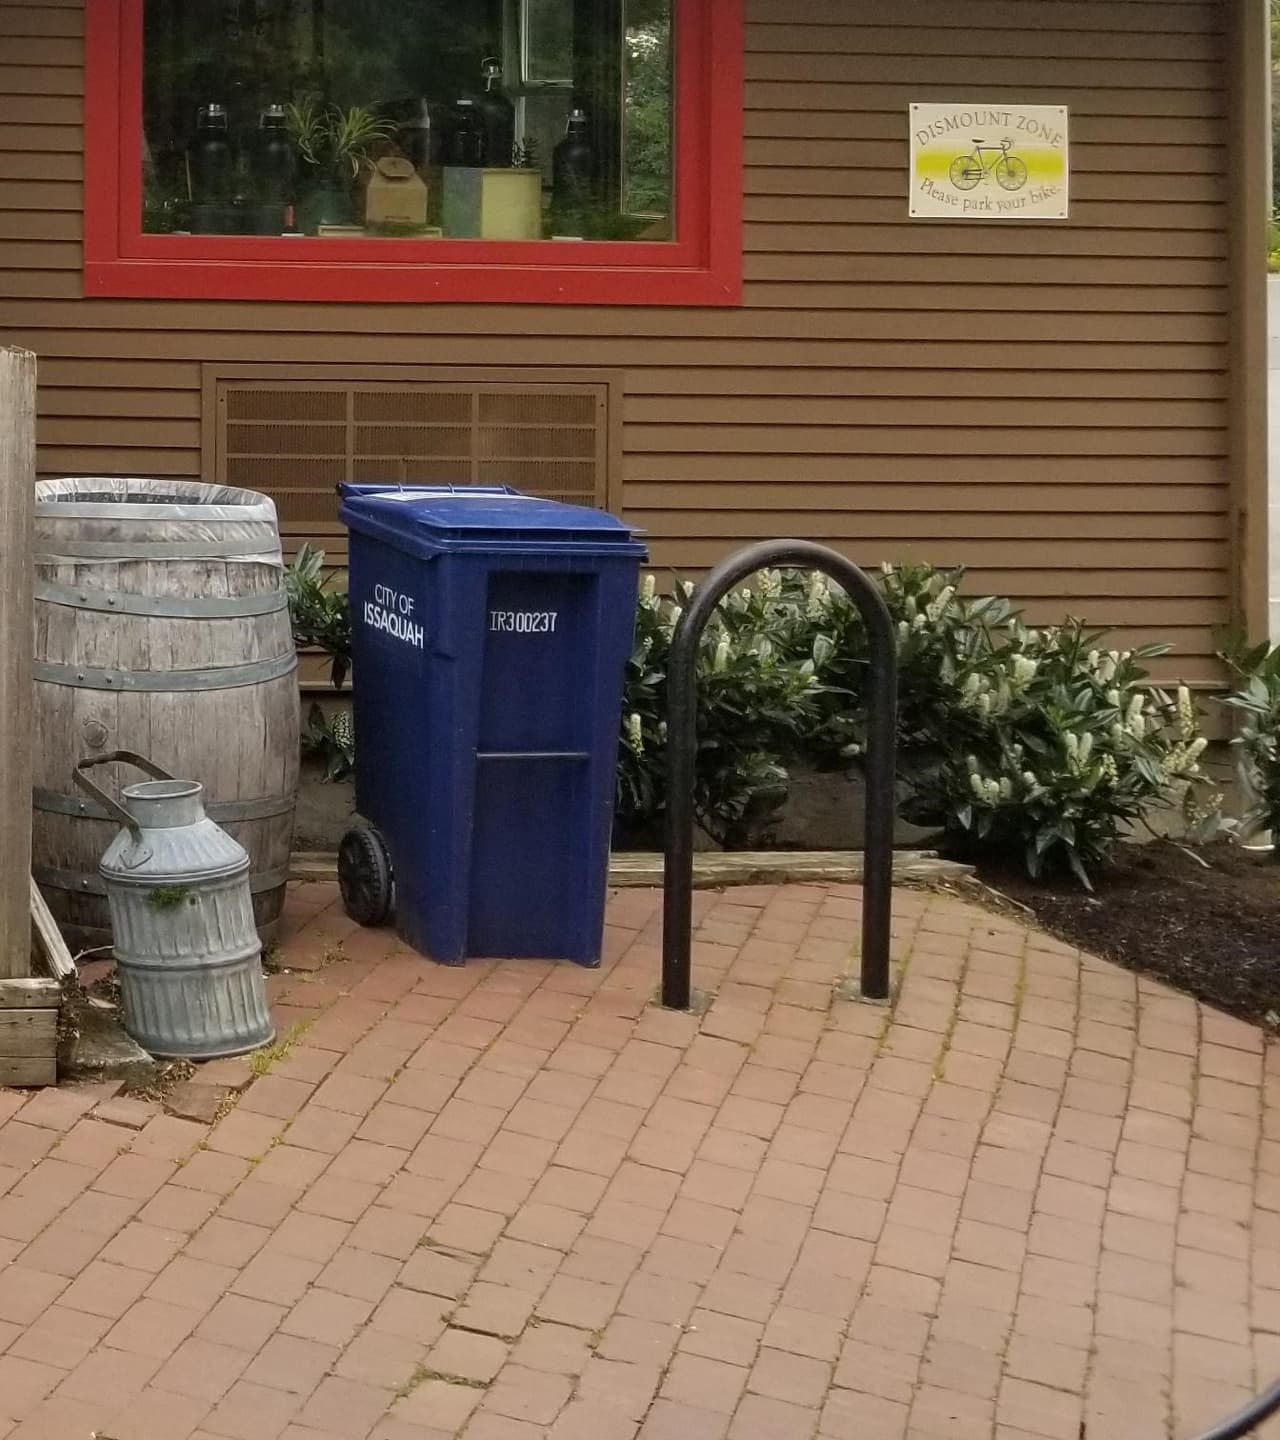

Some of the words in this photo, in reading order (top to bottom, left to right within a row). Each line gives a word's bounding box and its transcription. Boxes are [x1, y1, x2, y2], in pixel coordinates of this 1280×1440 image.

[916, 111, 1012, 146] DISMOUNT
[1016, 116, 1062, 148] ZONE
[920, 177, 958, 206] Please
[963, 196, 993, 212] park
[997, 197, 1026, 213] your
[375, 584, 398, 609] CITY
[399, 594, 415, 617] OF
[364, 601, 424, 649] ISSAQUAH
